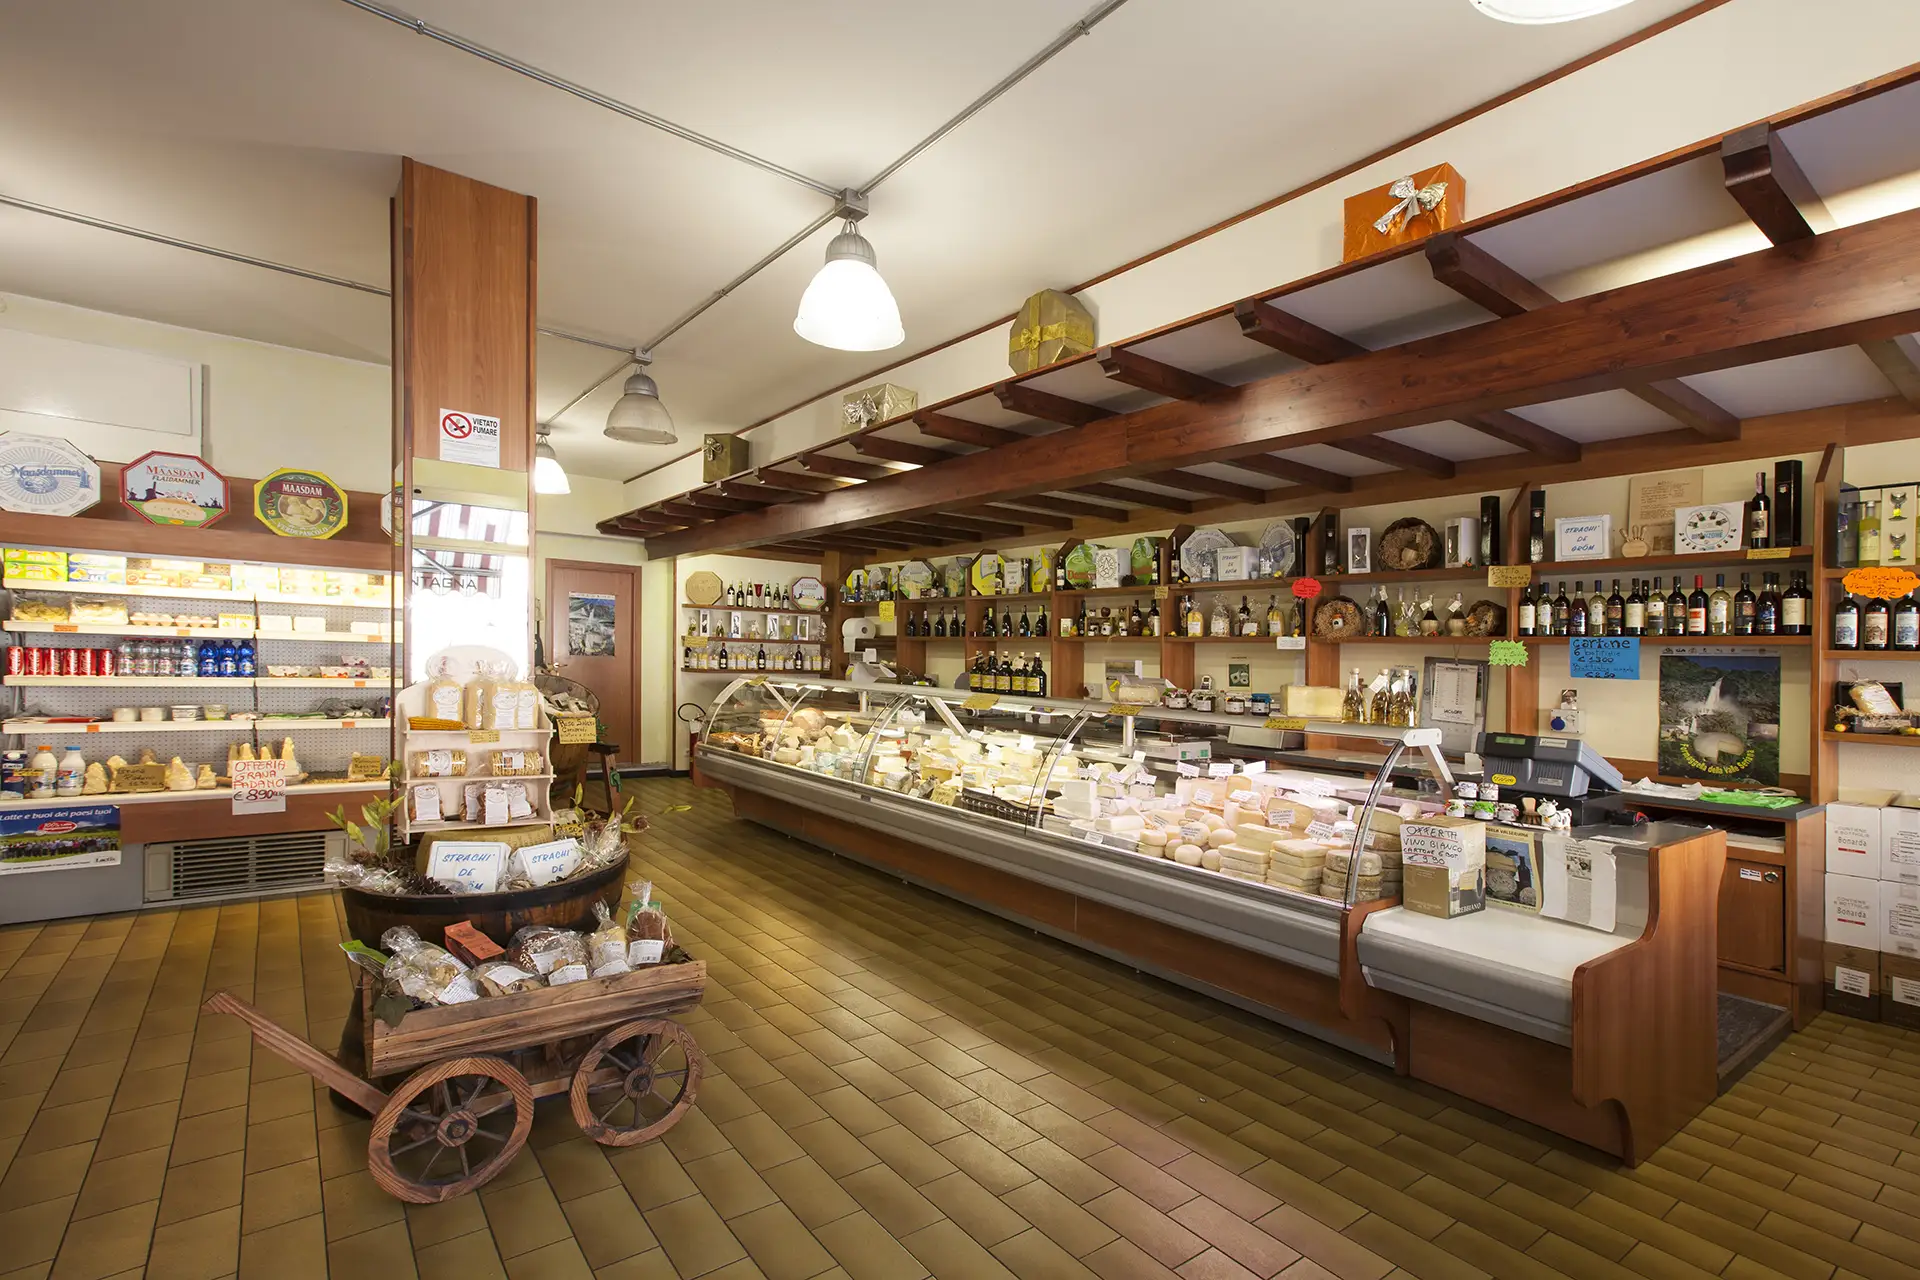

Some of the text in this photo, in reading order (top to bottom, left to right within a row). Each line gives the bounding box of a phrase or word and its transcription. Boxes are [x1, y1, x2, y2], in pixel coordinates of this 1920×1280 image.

[472, 418, 498, 428] VIETATO
[473, 426, 498, 437] FUMARE
[146, 465, 205, 481] MAASDAM
[282, 483, 323, 496] MAASDAM
[1574, 648, 1581, 656] 6
[1707, 766, 1723, 774] della
[1724, 763, 1740, 774] Valle
[233, 779, 284, 789] PADANO
[234, 791, 243, 801] €
[32, 811, 53, 819] buoi
[54, 810, 68, 818] dei
[70, 809, 93, 818] paesi
[1406, 826, 1457, 840] OFFERTA
[1403, 838, 1462, 852] VINO BIANCO
[1838, 836, 1867, 847] Bonarda
[442, 853, 496, 863] STRACHI'
[532, 849, 572, 863] STRACHI'
[458, 868, 475, 877] DE
[551, 864, 564, 873] DE
[1837, 907, 1866, 919] Bonarda
